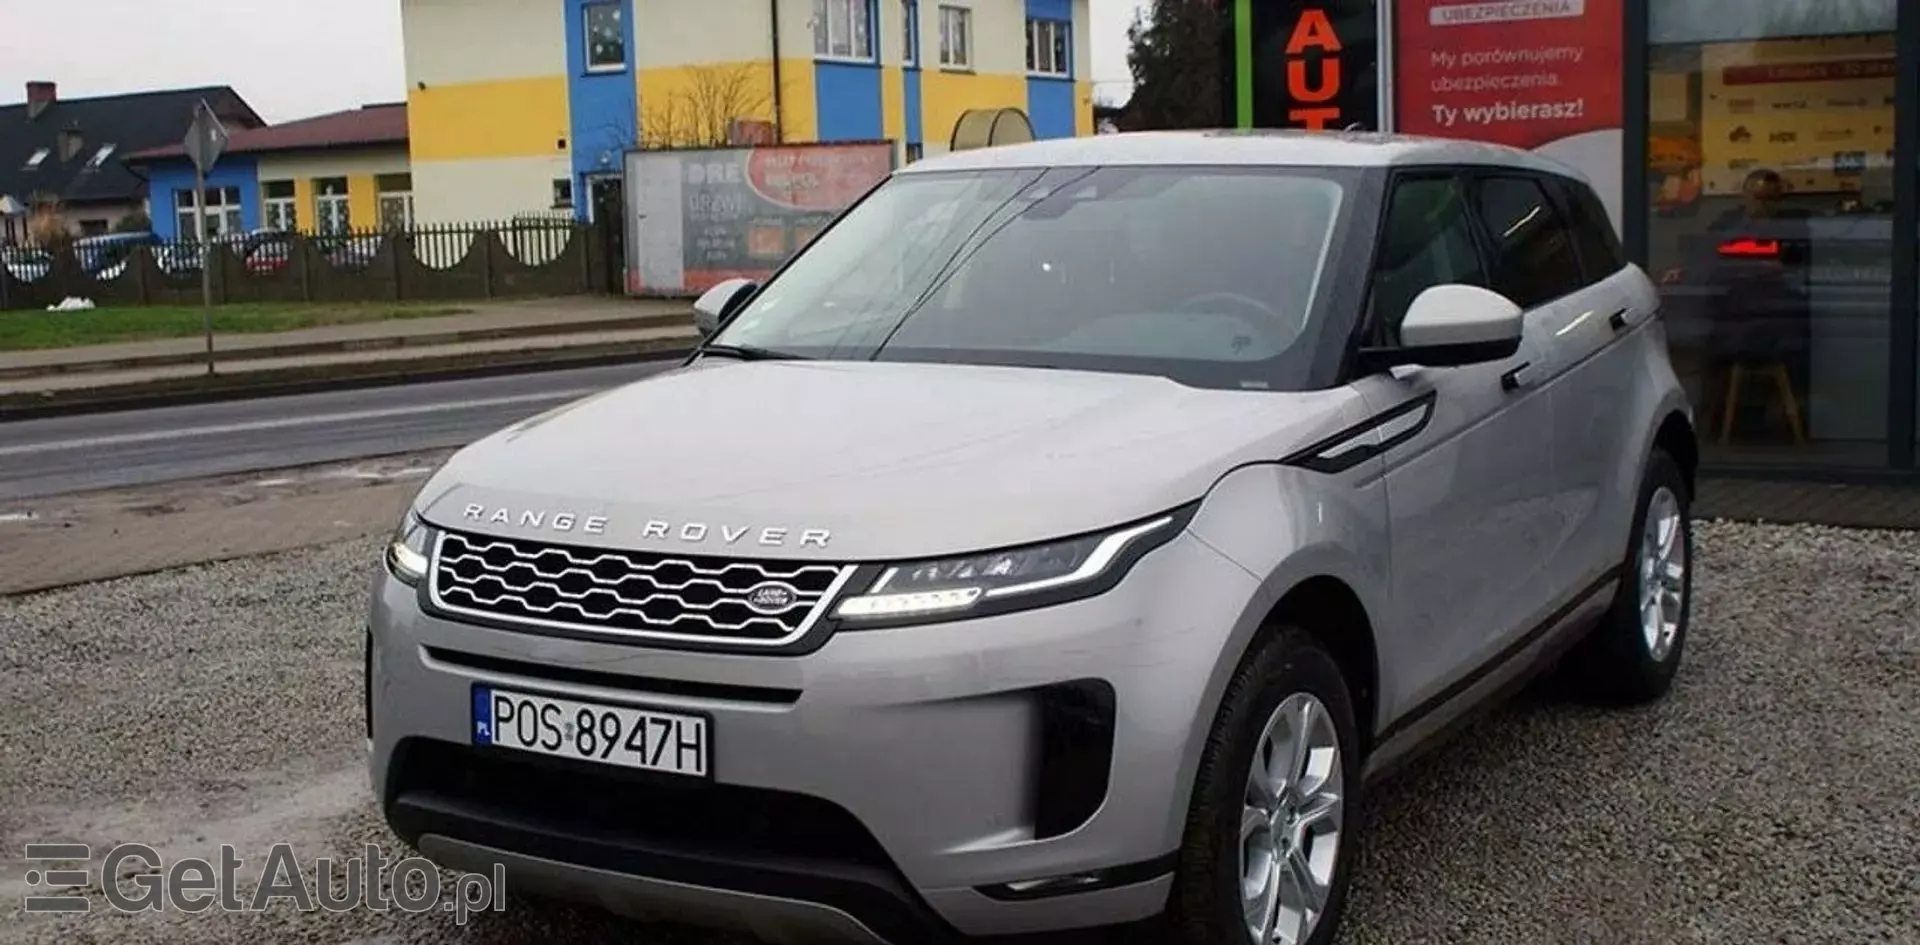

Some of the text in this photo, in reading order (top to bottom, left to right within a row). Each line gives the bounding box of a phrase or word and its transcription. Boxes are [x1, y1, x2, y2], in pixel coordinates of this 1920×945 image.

[1442, 1, 1571, 21] UBEZPIECZENIA
[1431, 45, 1584, 69] My porównujemy
[1432, 98, 1584, 126] Ty wybierasz!
[463, 502, 832, 548] RANGE ROVER
[494, 694, 702, 773] POS 8947H
